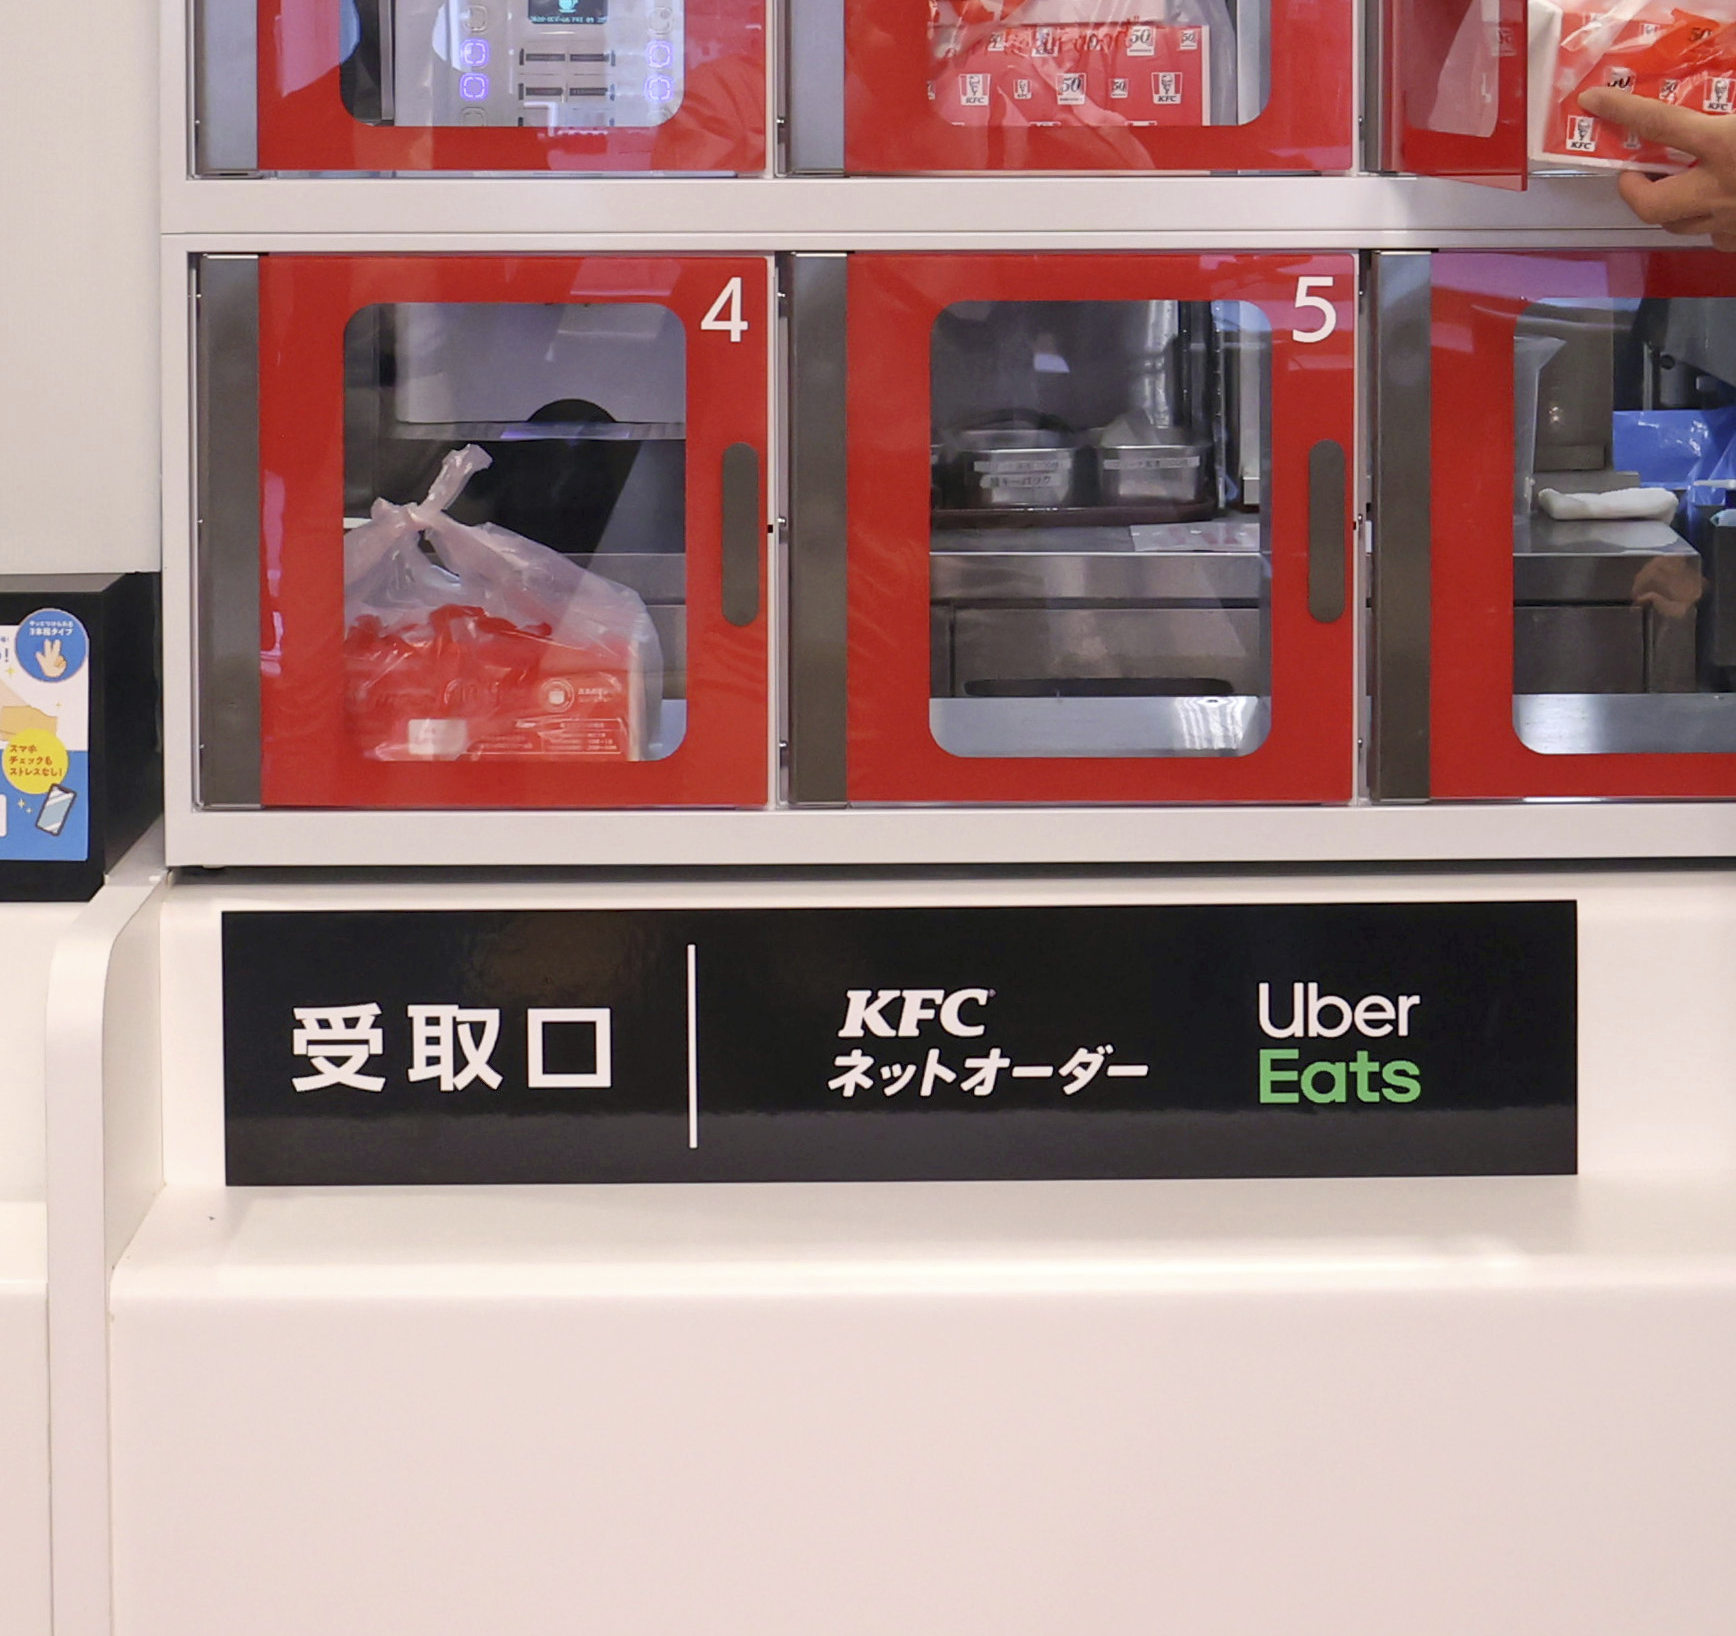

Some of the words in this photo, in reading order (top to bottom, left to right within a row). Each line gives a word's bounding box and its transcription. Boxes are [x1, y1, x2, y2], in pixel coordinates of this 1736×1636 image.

[1129, 30, 1151, 45] 50
[1061, 78, 1082, 94] 50
[1157, 95, 1177, 103] KFC
[1708, 102, 1731, 111] KFC
[1570, 141, 1592, 149] KFC
[700, 276, 749, 343] 4
[1289, 275, 1337, 343] 5
[839, 987, 990, 1038] KFC
[1256, 981, 1421, 1038] Uber
[291, 1002, 613, 1093] 受取口
[826, 1047, 1149, 1099] ネットオーダー
[1258, 1048, 1422, 1105] Eats
